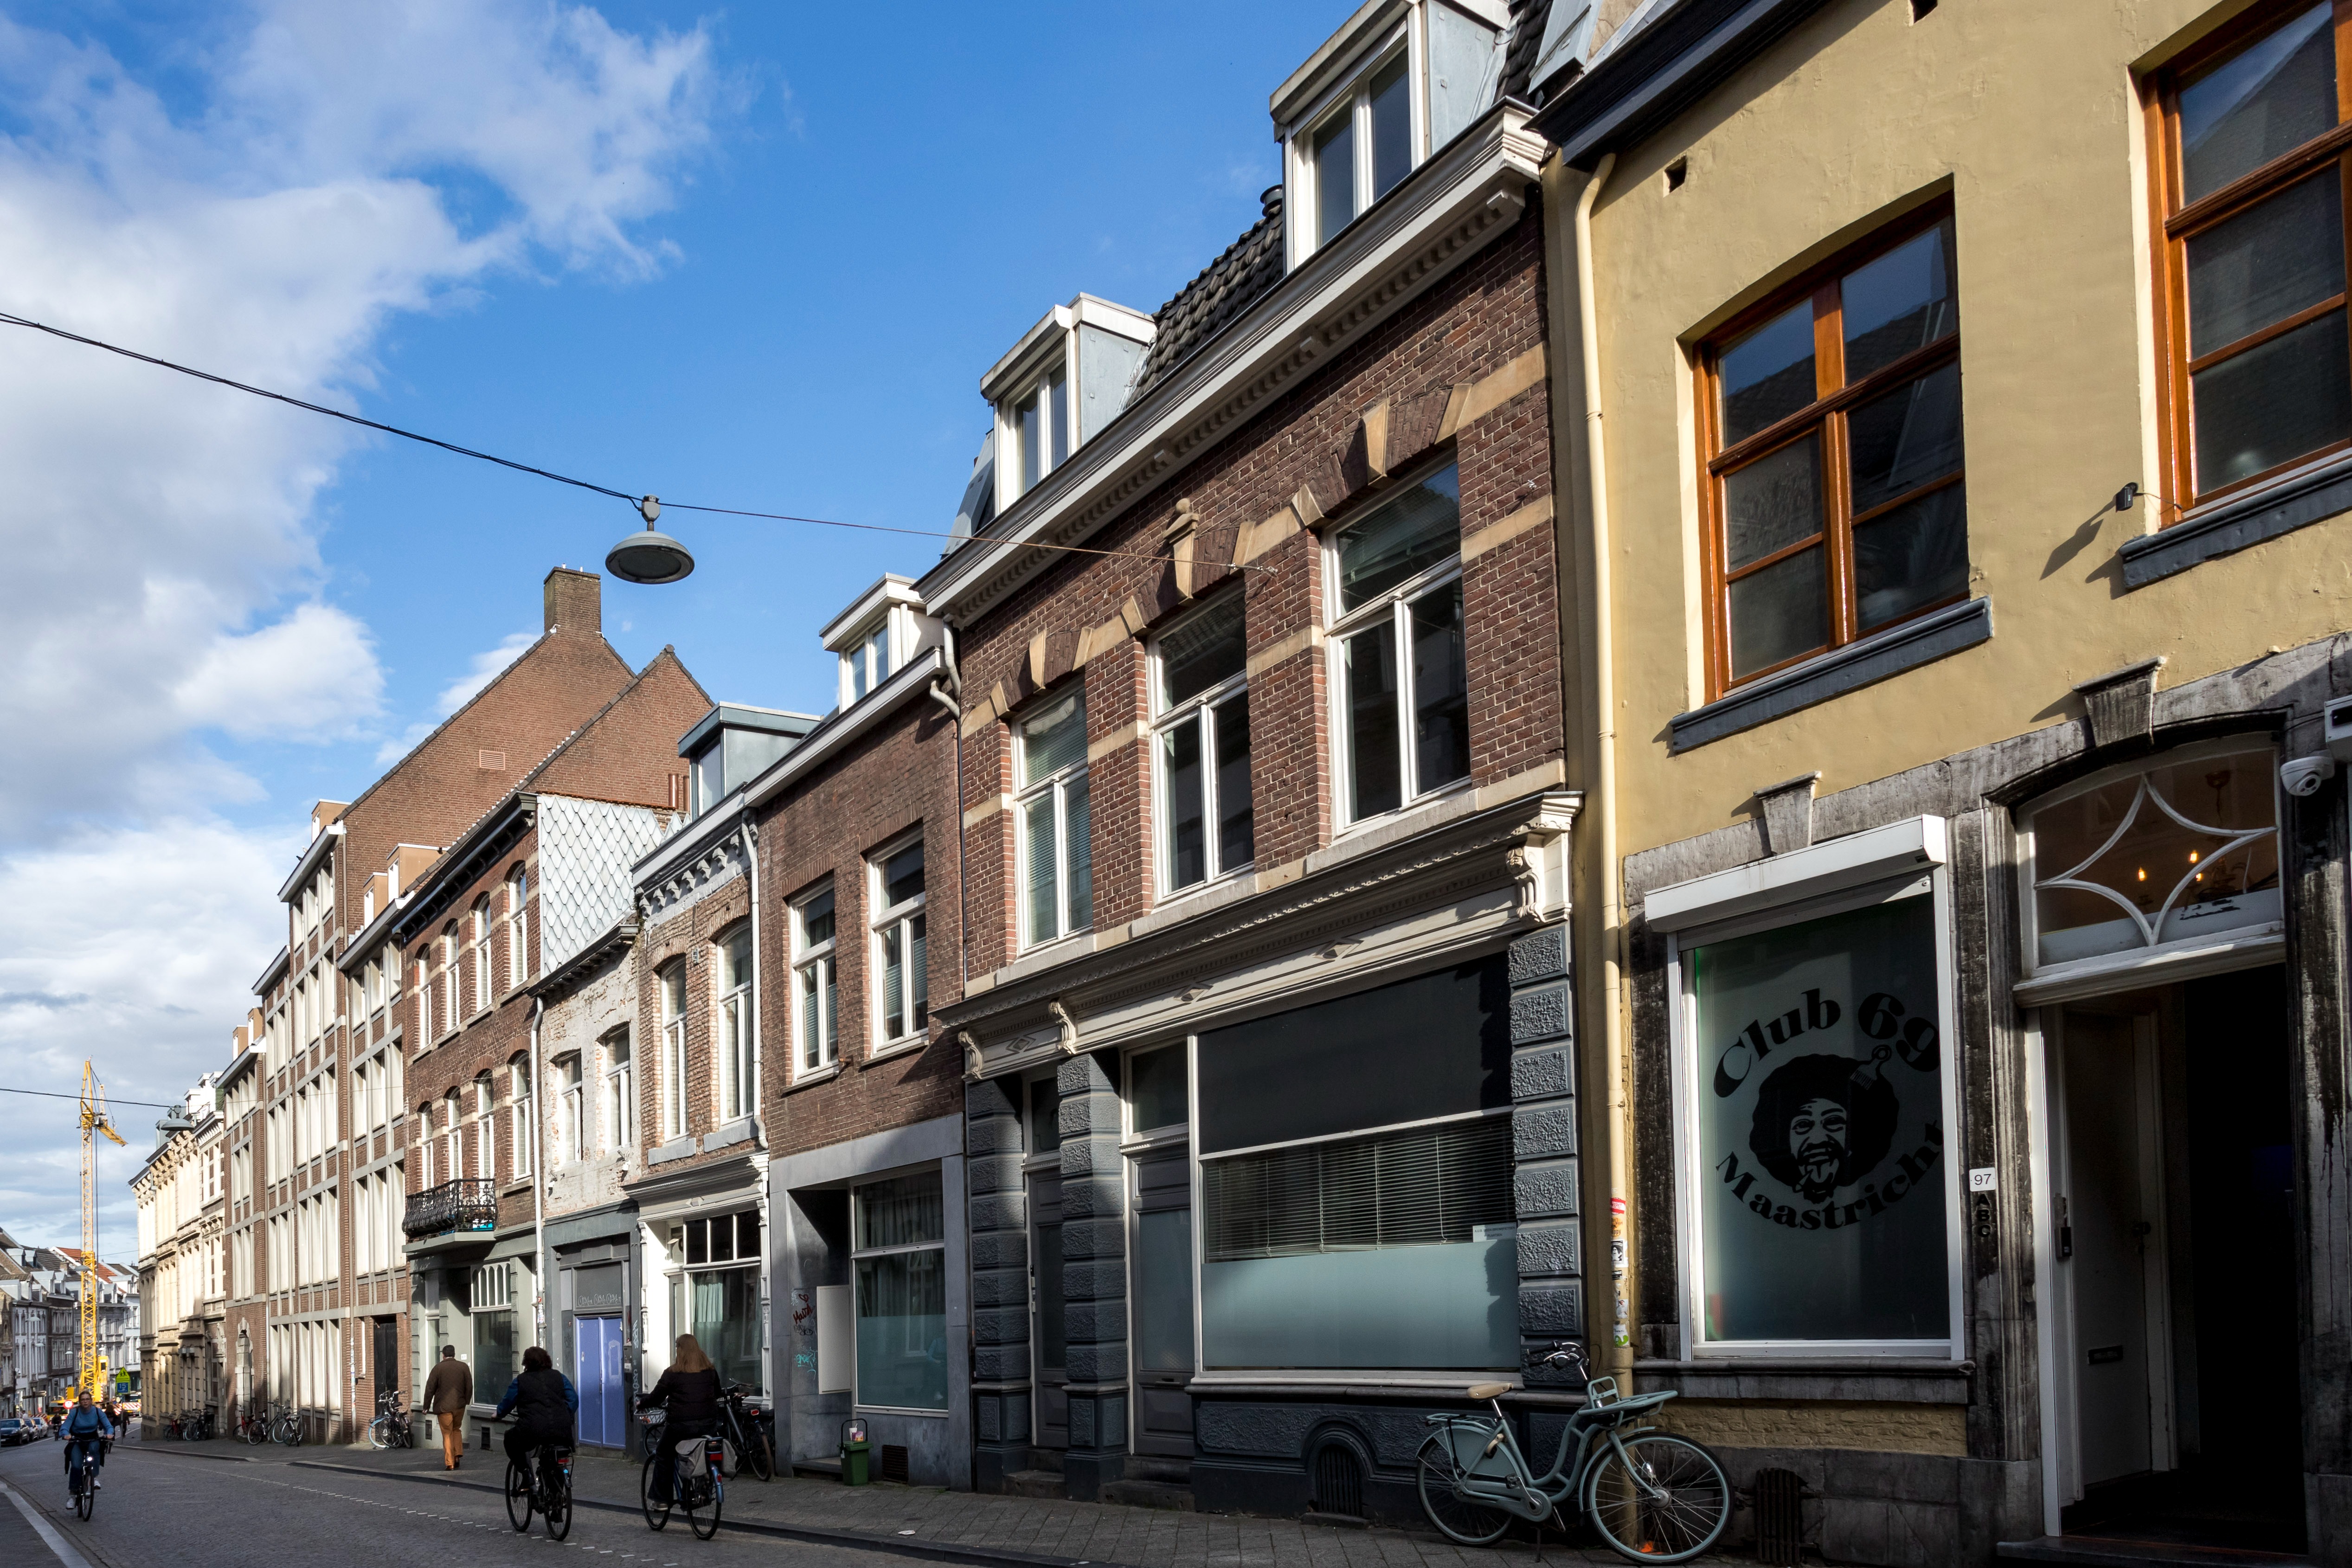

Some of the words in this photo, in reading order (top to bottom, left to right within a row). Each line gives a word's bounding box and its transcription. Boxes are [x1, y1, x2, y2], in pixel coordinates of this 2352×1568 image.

[1714, 988, 1841, 1098] Club
[1858, 992, 1941, 1072] 69
[1716, 1119, 1943, 1230] Maastricht
[1974, 1173, 1992, 1186] 97
